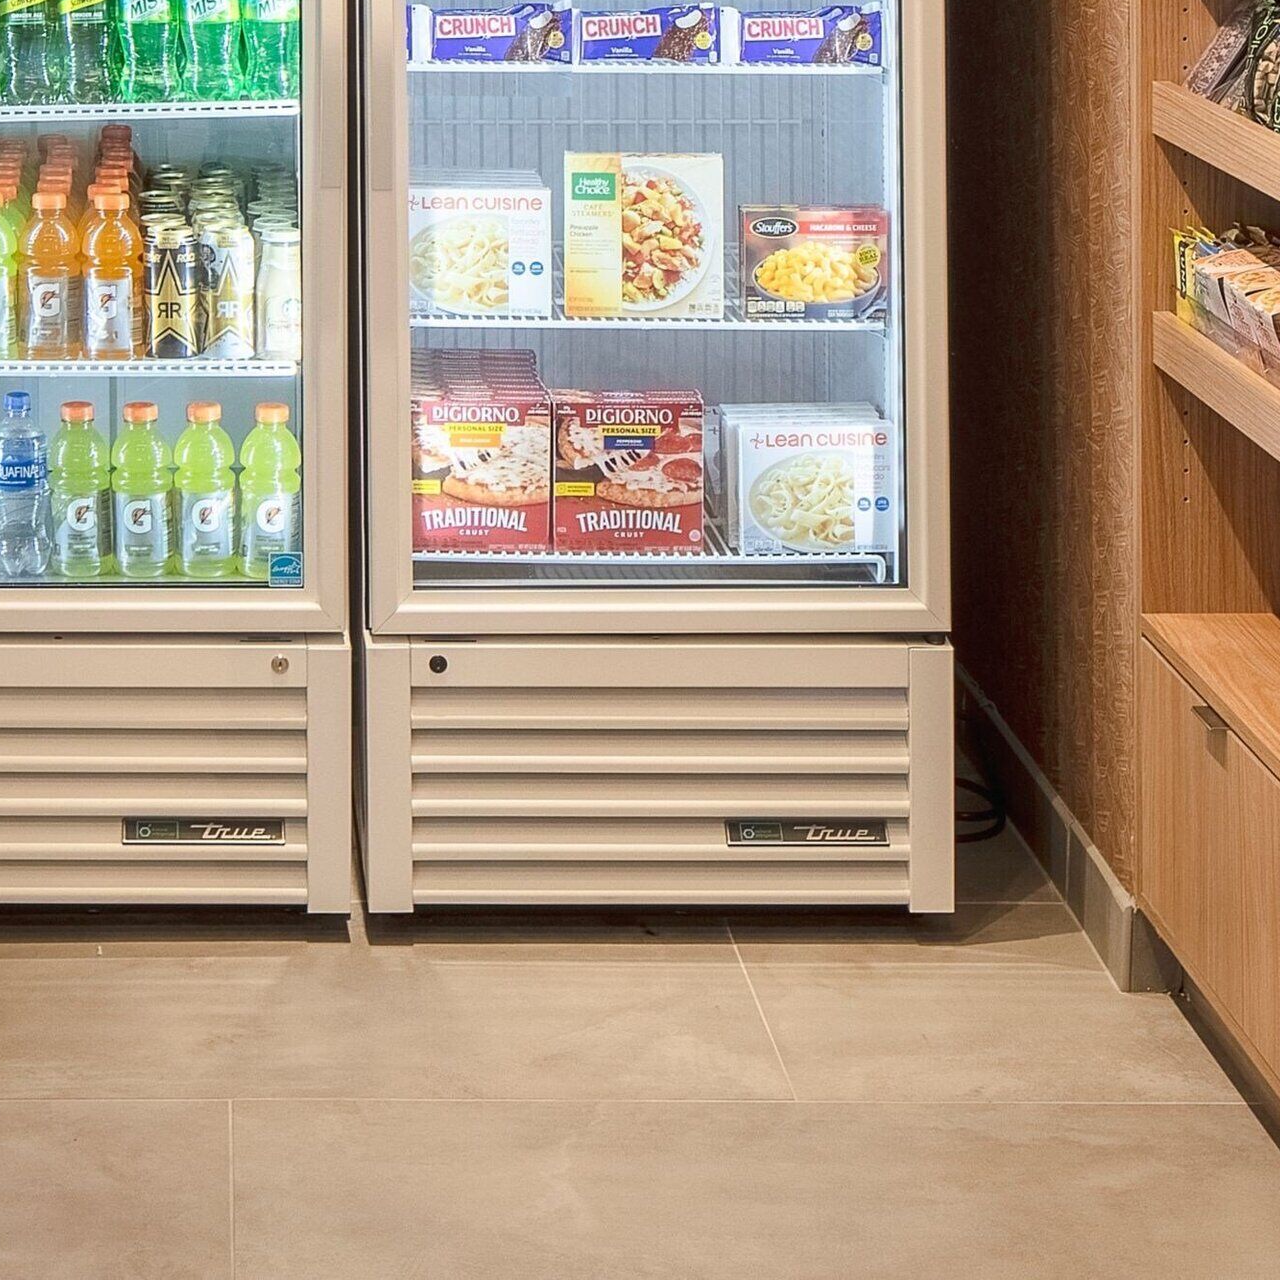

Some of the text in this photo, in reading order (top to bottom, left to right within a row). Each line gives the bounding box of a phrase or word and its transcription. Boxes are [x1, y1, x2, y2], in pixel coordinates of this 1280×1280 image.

[439, 16, 512, 35] CRUNCH
[585, 16, 658, 37] CRUNCH
[747, 18, 821, 38] CRUNCH
[574, 185, 610, 195] Choice
[579, 177, 610, 189] Healthy
[422, 195, 543, 211] Lean cuisine
[755, 221, 793, 235] Stouffer's
[433, 406, 520, 422] DIGIORNO
[586, 408, 674, 424] DIGIORNO
[766, 432, 887, 447] Lean cuisine
[421, 507, 527, 531] TRADITIONAL
[576, 510, 682, 533] TRADITIONAL
